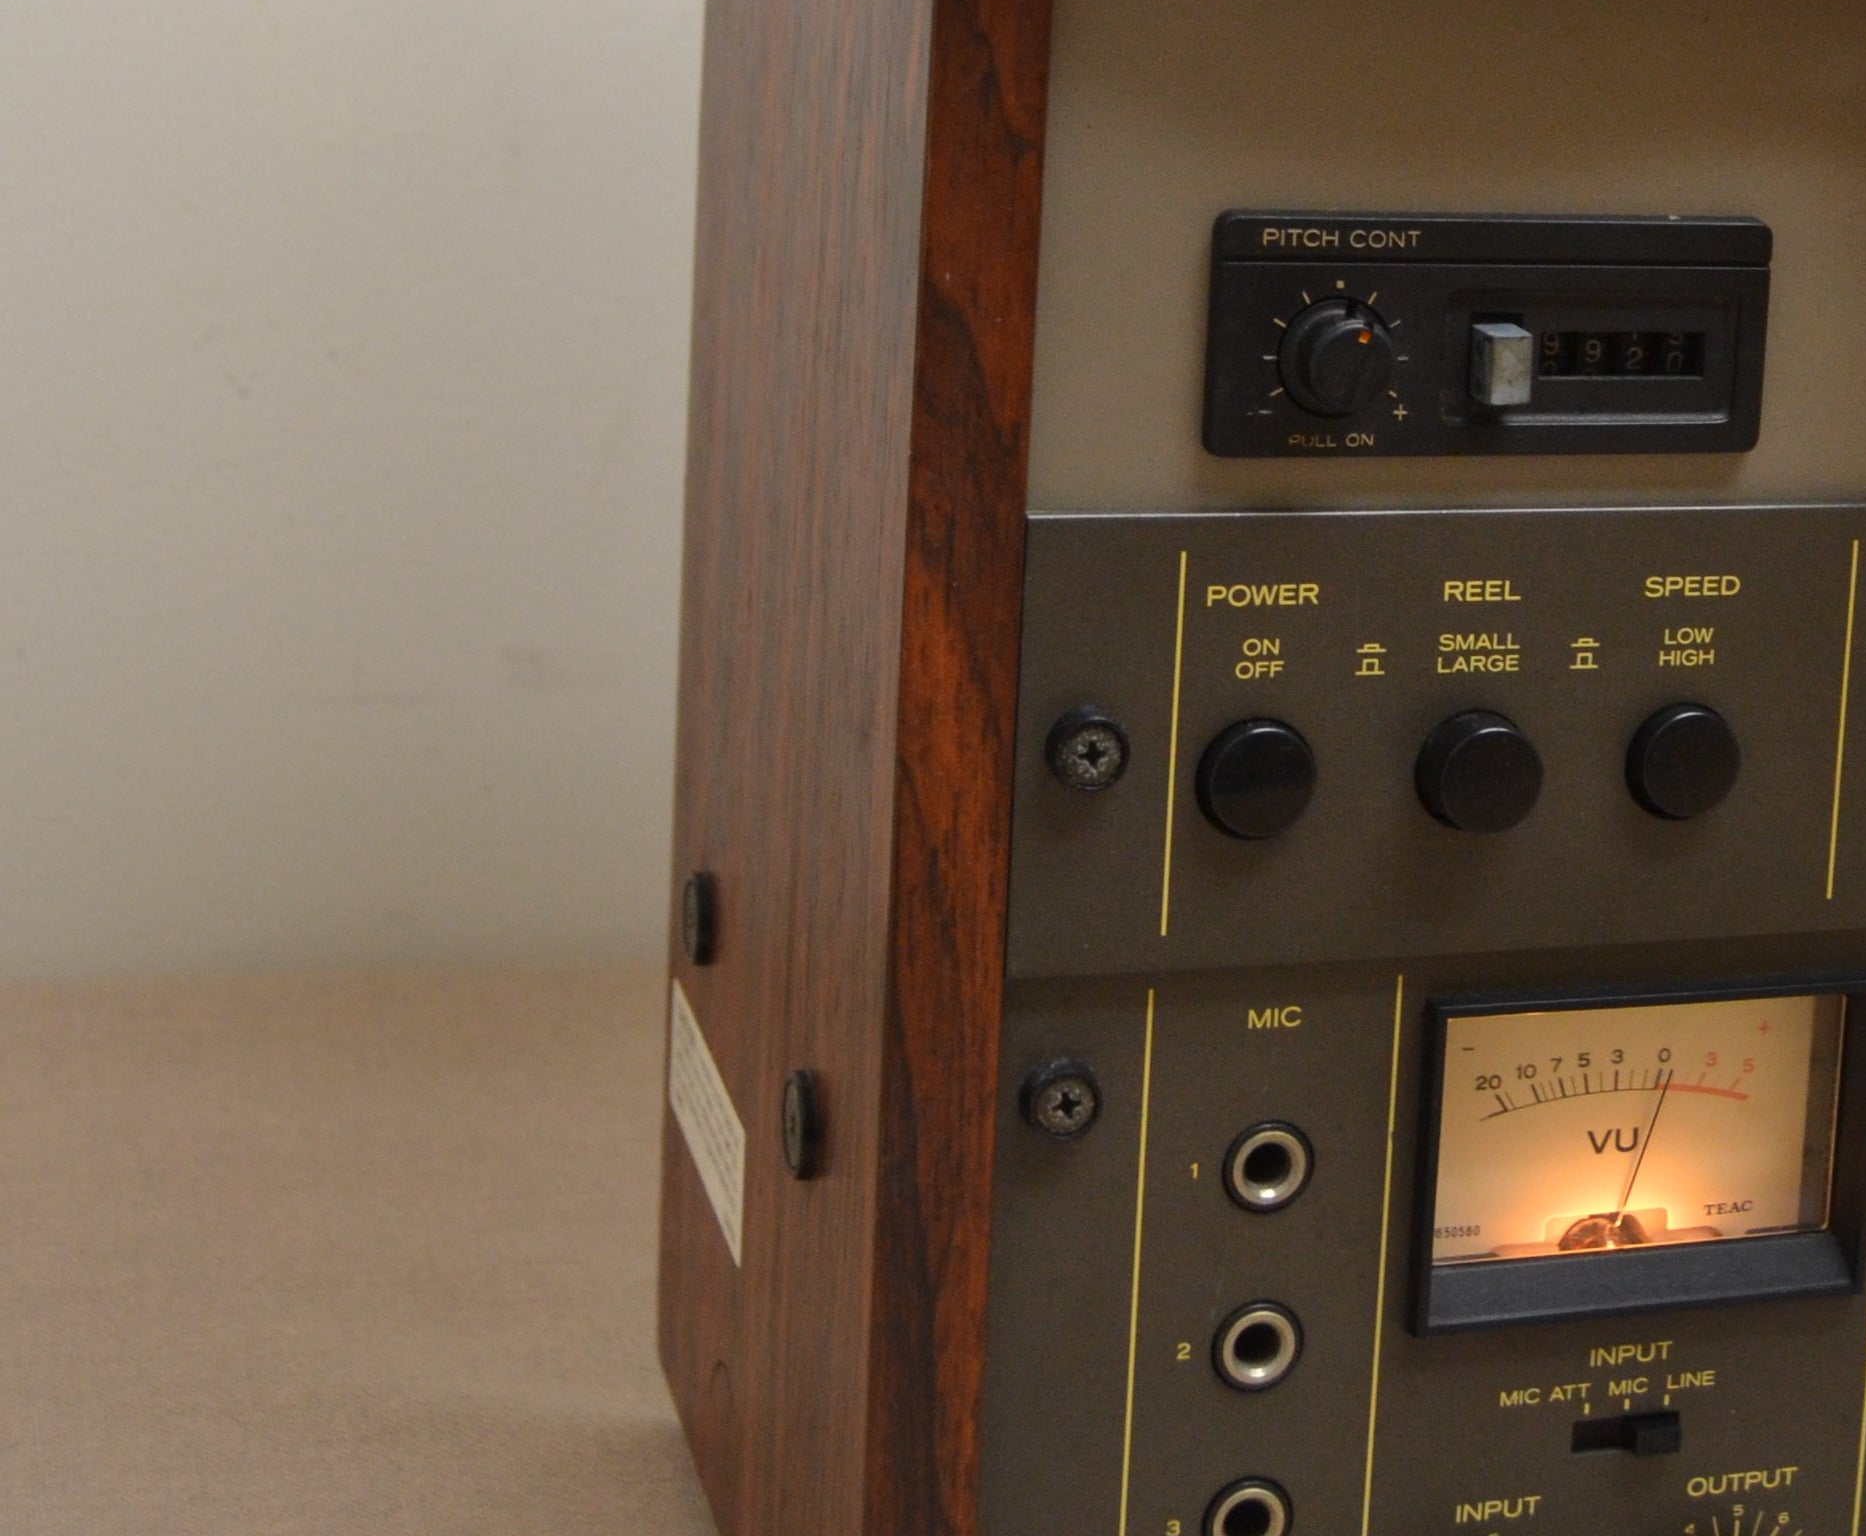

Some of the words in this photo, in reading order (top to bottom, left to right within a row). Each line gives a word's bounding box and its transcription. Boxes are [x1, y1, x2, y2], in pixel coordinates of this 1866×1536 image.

[1263, 228, 1339, 248] PITCH
[1349, 230, 1421, 249] CONT
[1288, 433, 1337, 448] PULL
[1346, 433, 1375, 448] ON
[1206, 583, 1321, 608] POWER
[1443, 579, 1522, 603] REEL
[1644, 575, 1741, 598] SPEED
[1437, 632, 1520, 652] SMALL
[1663, 627, 1714, 645] LOW
[1242, 638, 1281, 657] ON
[1658, 648, 1716, 667] HIGH
[1234, 660, 1285, 679] OFF
[1437, 655, 1520, 674] LARGE
[1247, 1007, 1303, 1030] MIC
[1475, 1074, 1502, 1091] 20
[1517, 1064, 1537, 1080] 10
[1551, 1058, 1562, 1072] 7
[1577, 1052, 1591, 1068] 5
[1611, 1049, 1624, 1064] 3
[1658, 1048, 1671, 1063] 0
[1705, 1052, 1717, 1067] 3
[1743, 1058, 1755, 1073] 5
[1588, 1127, 1639, 1155] VU
[1190, 1163, 1198, 1179] 1
[1703, 1200, 1754, 1215] TEAC
[1177, 1343, 1192, 1360] 2
[1590, 1340, 1673, 1367] INPUT
[1500, 1389, 1541, 1408] MIC
[1549, 1383, 1592, 1402] ATT
[1608, 1377, 1649, 1397] MIC
[1666, 1371, 1716, 1390] LINE
[1686, 1466, 1798, 1497] OUTPUT
[1455, 1496, 1542, 1524] INPUT
[1684, 1524, 1695, 1534] 4
[1733, 1505, 1744, 1516] 5
[1778, 1512, 1789, 1524] 6
[1166, 1520, 1181, 1536] 3
